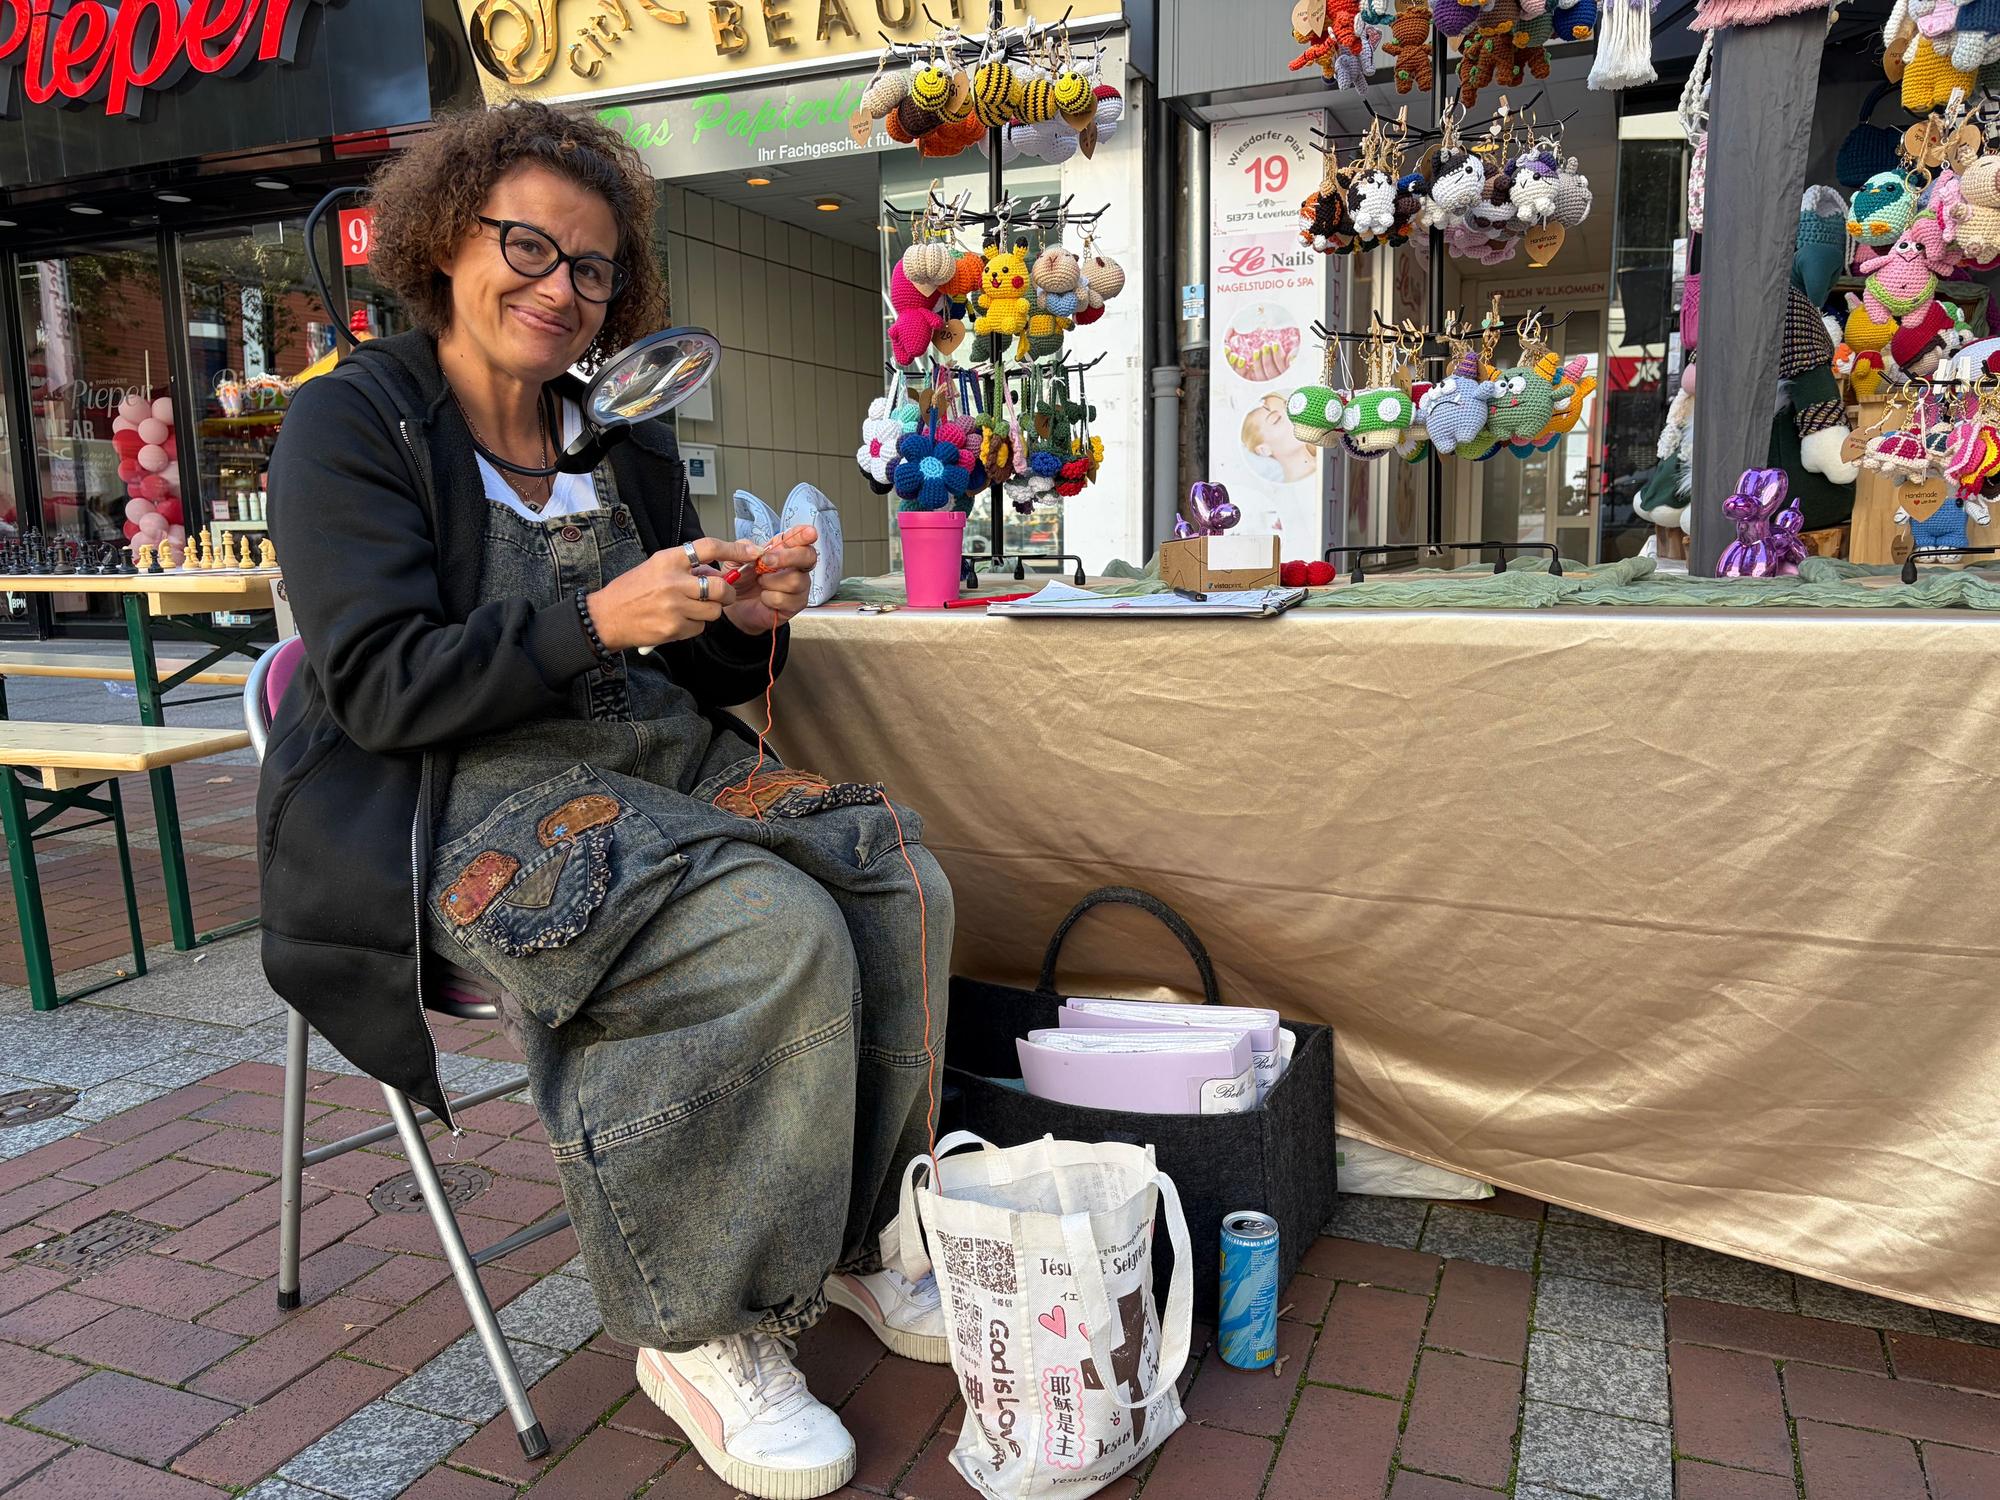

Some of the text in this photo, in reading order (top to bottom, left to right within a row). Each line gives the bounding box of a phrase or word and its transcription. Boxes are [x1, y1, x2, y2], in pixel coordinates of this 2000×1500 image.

[708, 0, 1026, 56] BEAU
[597, 82, 866, 150] Das Papierli
[758, 146, 776, 161] Ihr
[779, 136, 873, 160] Fachgescht
[1227, 130, 1305, 167] Wiesdorfer Platz
[1245, 155, 1289, 194] 19
[1226, 208, 1300, 222] 51373 Leverkuse
[1217, 246, 1314, 277] Le Nails
[1217, 277, 1314, 293] NAGELSTUDIO & SPA
[1536, 283, 1605, 297] WILLKOMMEN
[72, 379, 153, 418] Pieper
[1905, 491, 1938, 499] Handmade
[1040, 1258, 1072, 1276] Jésu
[990, 1319, 1015, 1374] God
[993, 1378, 1016, 1394] is
[1050, 1375, 1075, 1458] 耶穌是主
[1052, 1436, 1150, 1485] Yesus adalah Tuhan
[1095, 1431, 1131, 1459] Jesus
